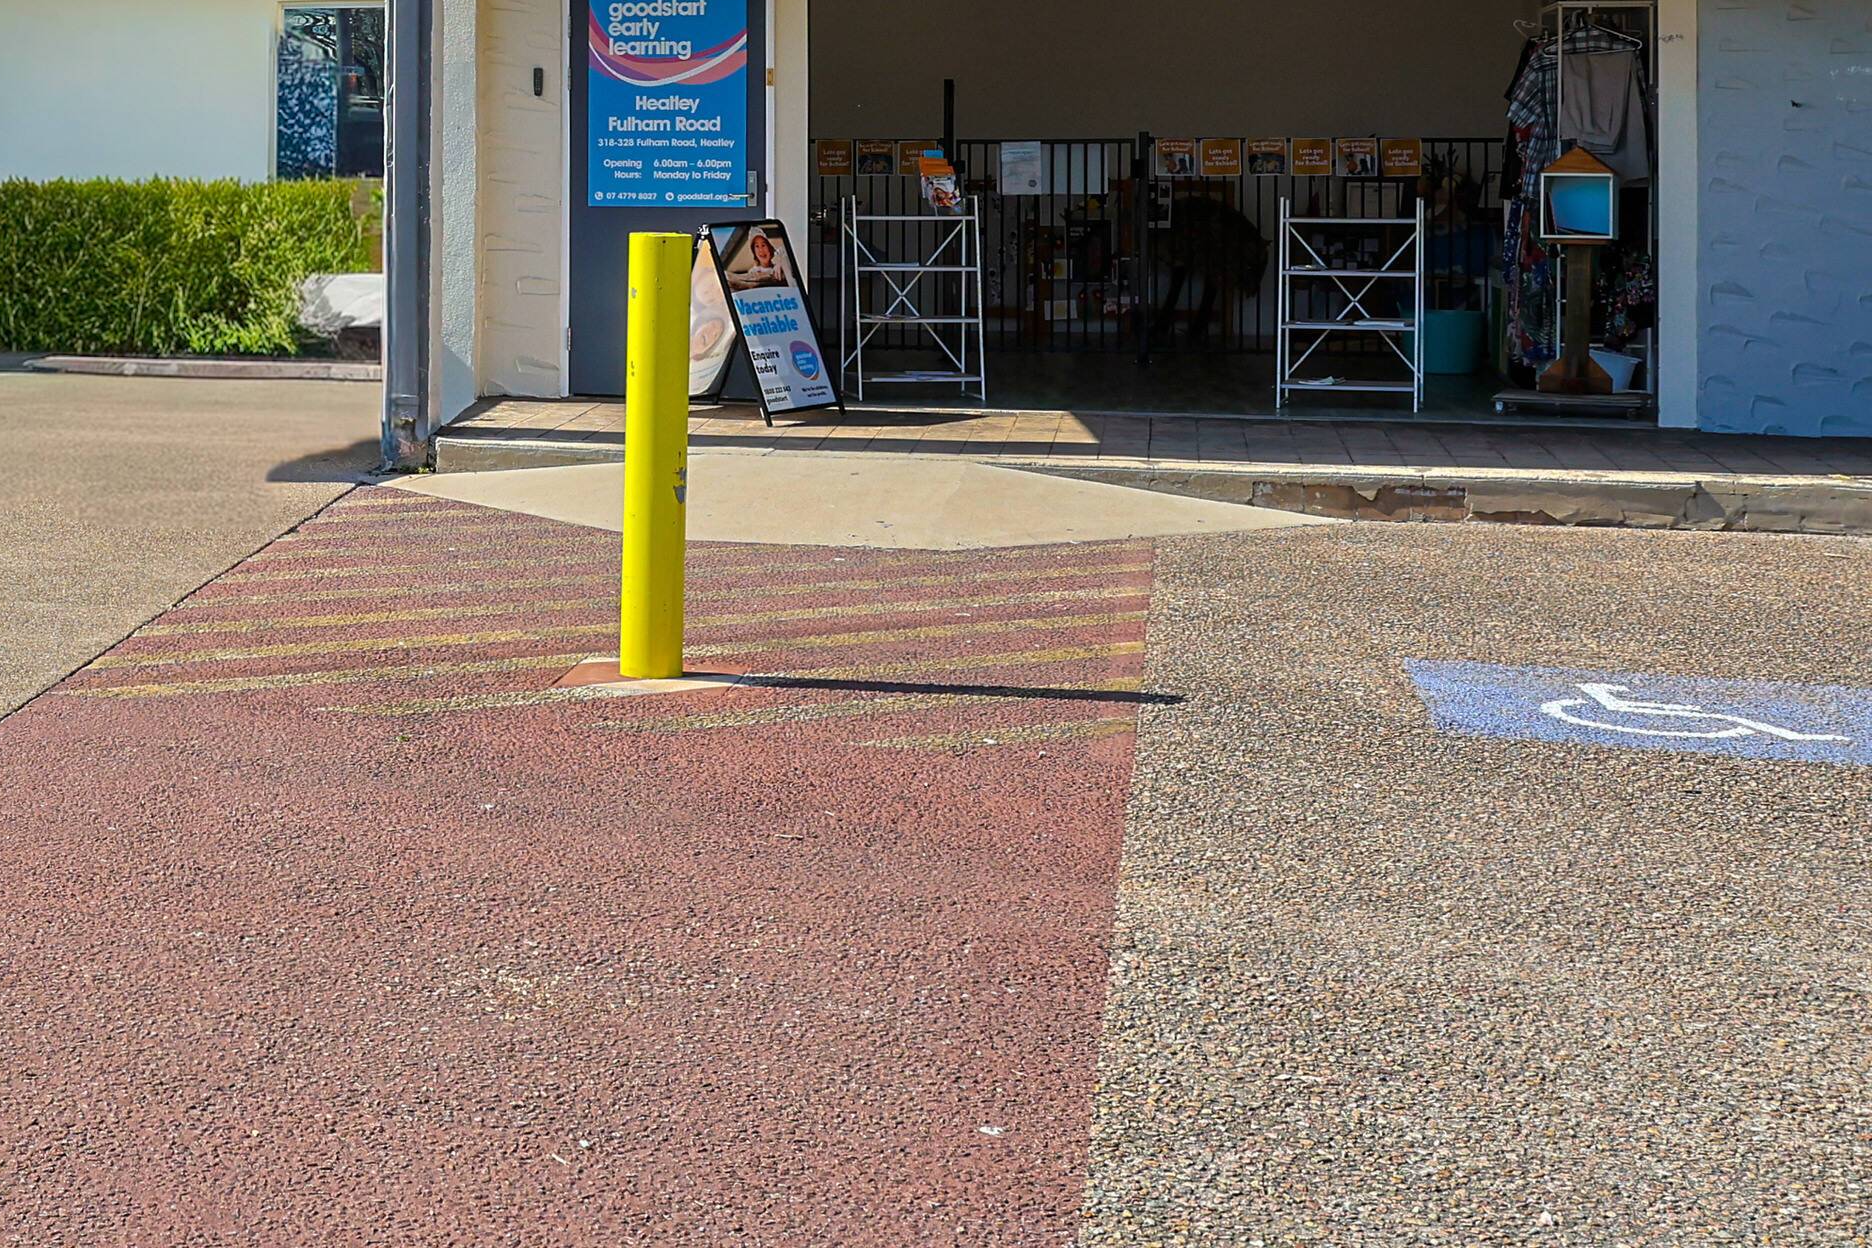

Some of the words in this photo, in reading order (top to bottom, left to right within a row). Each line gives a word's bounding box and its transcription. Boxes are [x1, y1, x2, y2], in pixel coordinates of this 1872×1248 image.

[608, 18, 660, 39] early
[608, 37, 692, 61] learning
[635, 95, 700, 113] Heatley
[608, 116, 671, 132] Fulham
[675, 116, 721, 132] Road
[636, 138, 669, 147] Fulham
[671, 138, 698, 148] Road,
[700, 138, 735, 149] Heatley
[603, 158, 643, 169] Opening
[653, 158, 688, 168] 6.00am
[696, 158, 732, 169] 6.00pm
[614, 170, 642, 180] Hours:
[653, 170, 690, 181] Monday
[702, 170, 732, 181] Friday
[734, 293, 799, 315] Vacancies
[743, 314, 799, 337] available
[751, 348, 780, 362] Enquire
[755, 362, 778, 375] today
